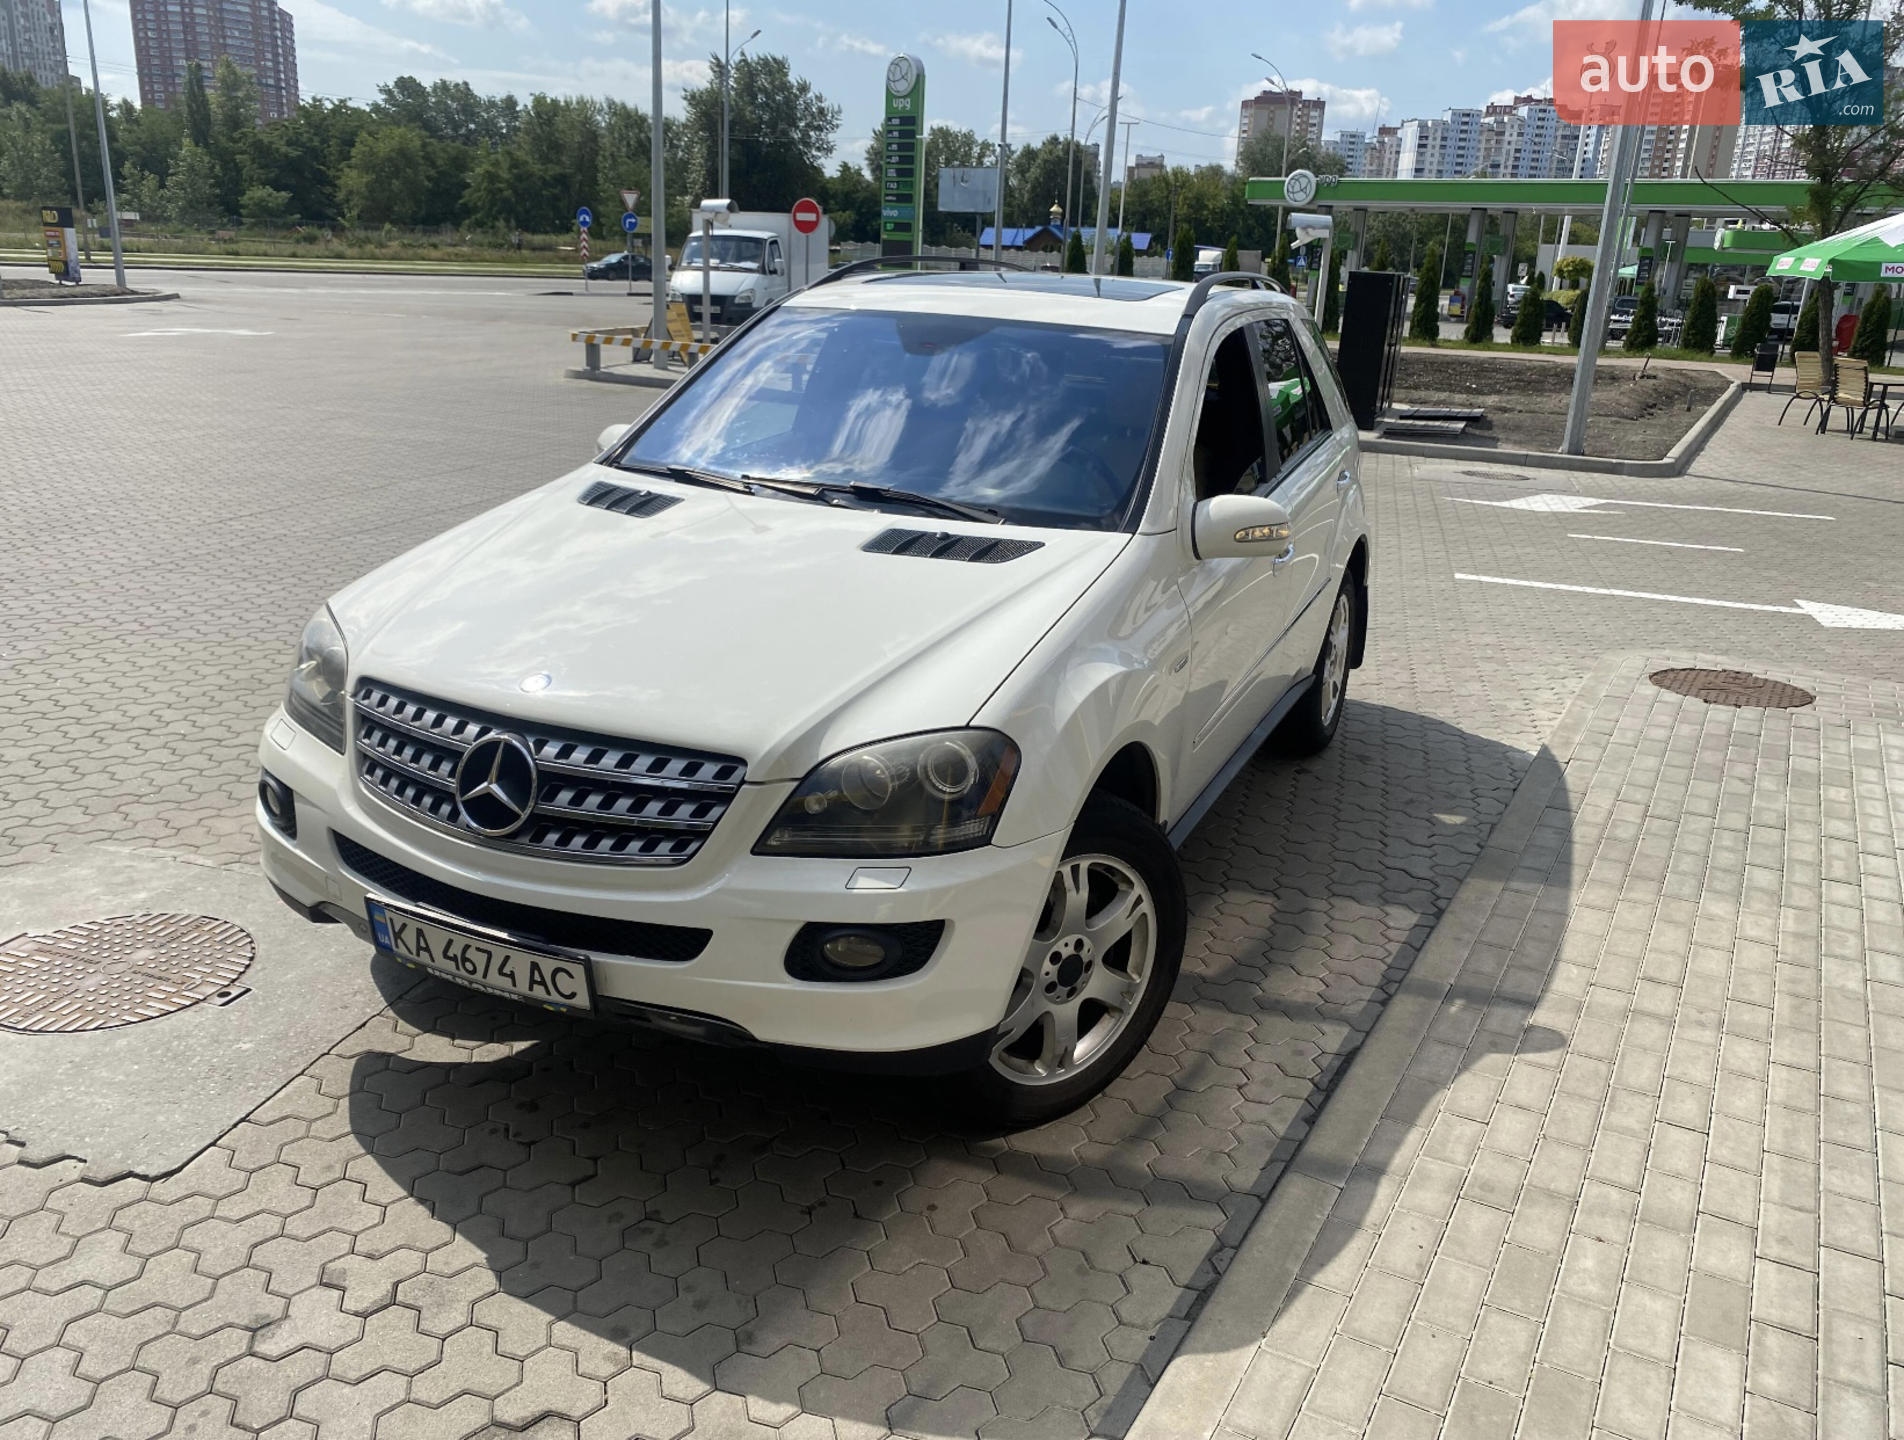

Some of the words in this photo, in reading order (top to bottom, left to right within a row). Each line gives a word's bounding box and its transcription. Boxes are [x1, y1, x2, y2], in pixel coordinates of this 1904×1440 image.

[892, 98, 911, 111] upg
[1318, 175, 1339, 187] upg
[882, 207, 899, 217] vivo
[378, 932, 391, 946] UA
[388, 917, 435, 963] KA
[442, 939, 517, 988] 4674
[528, 960, 577, 1000] AC
